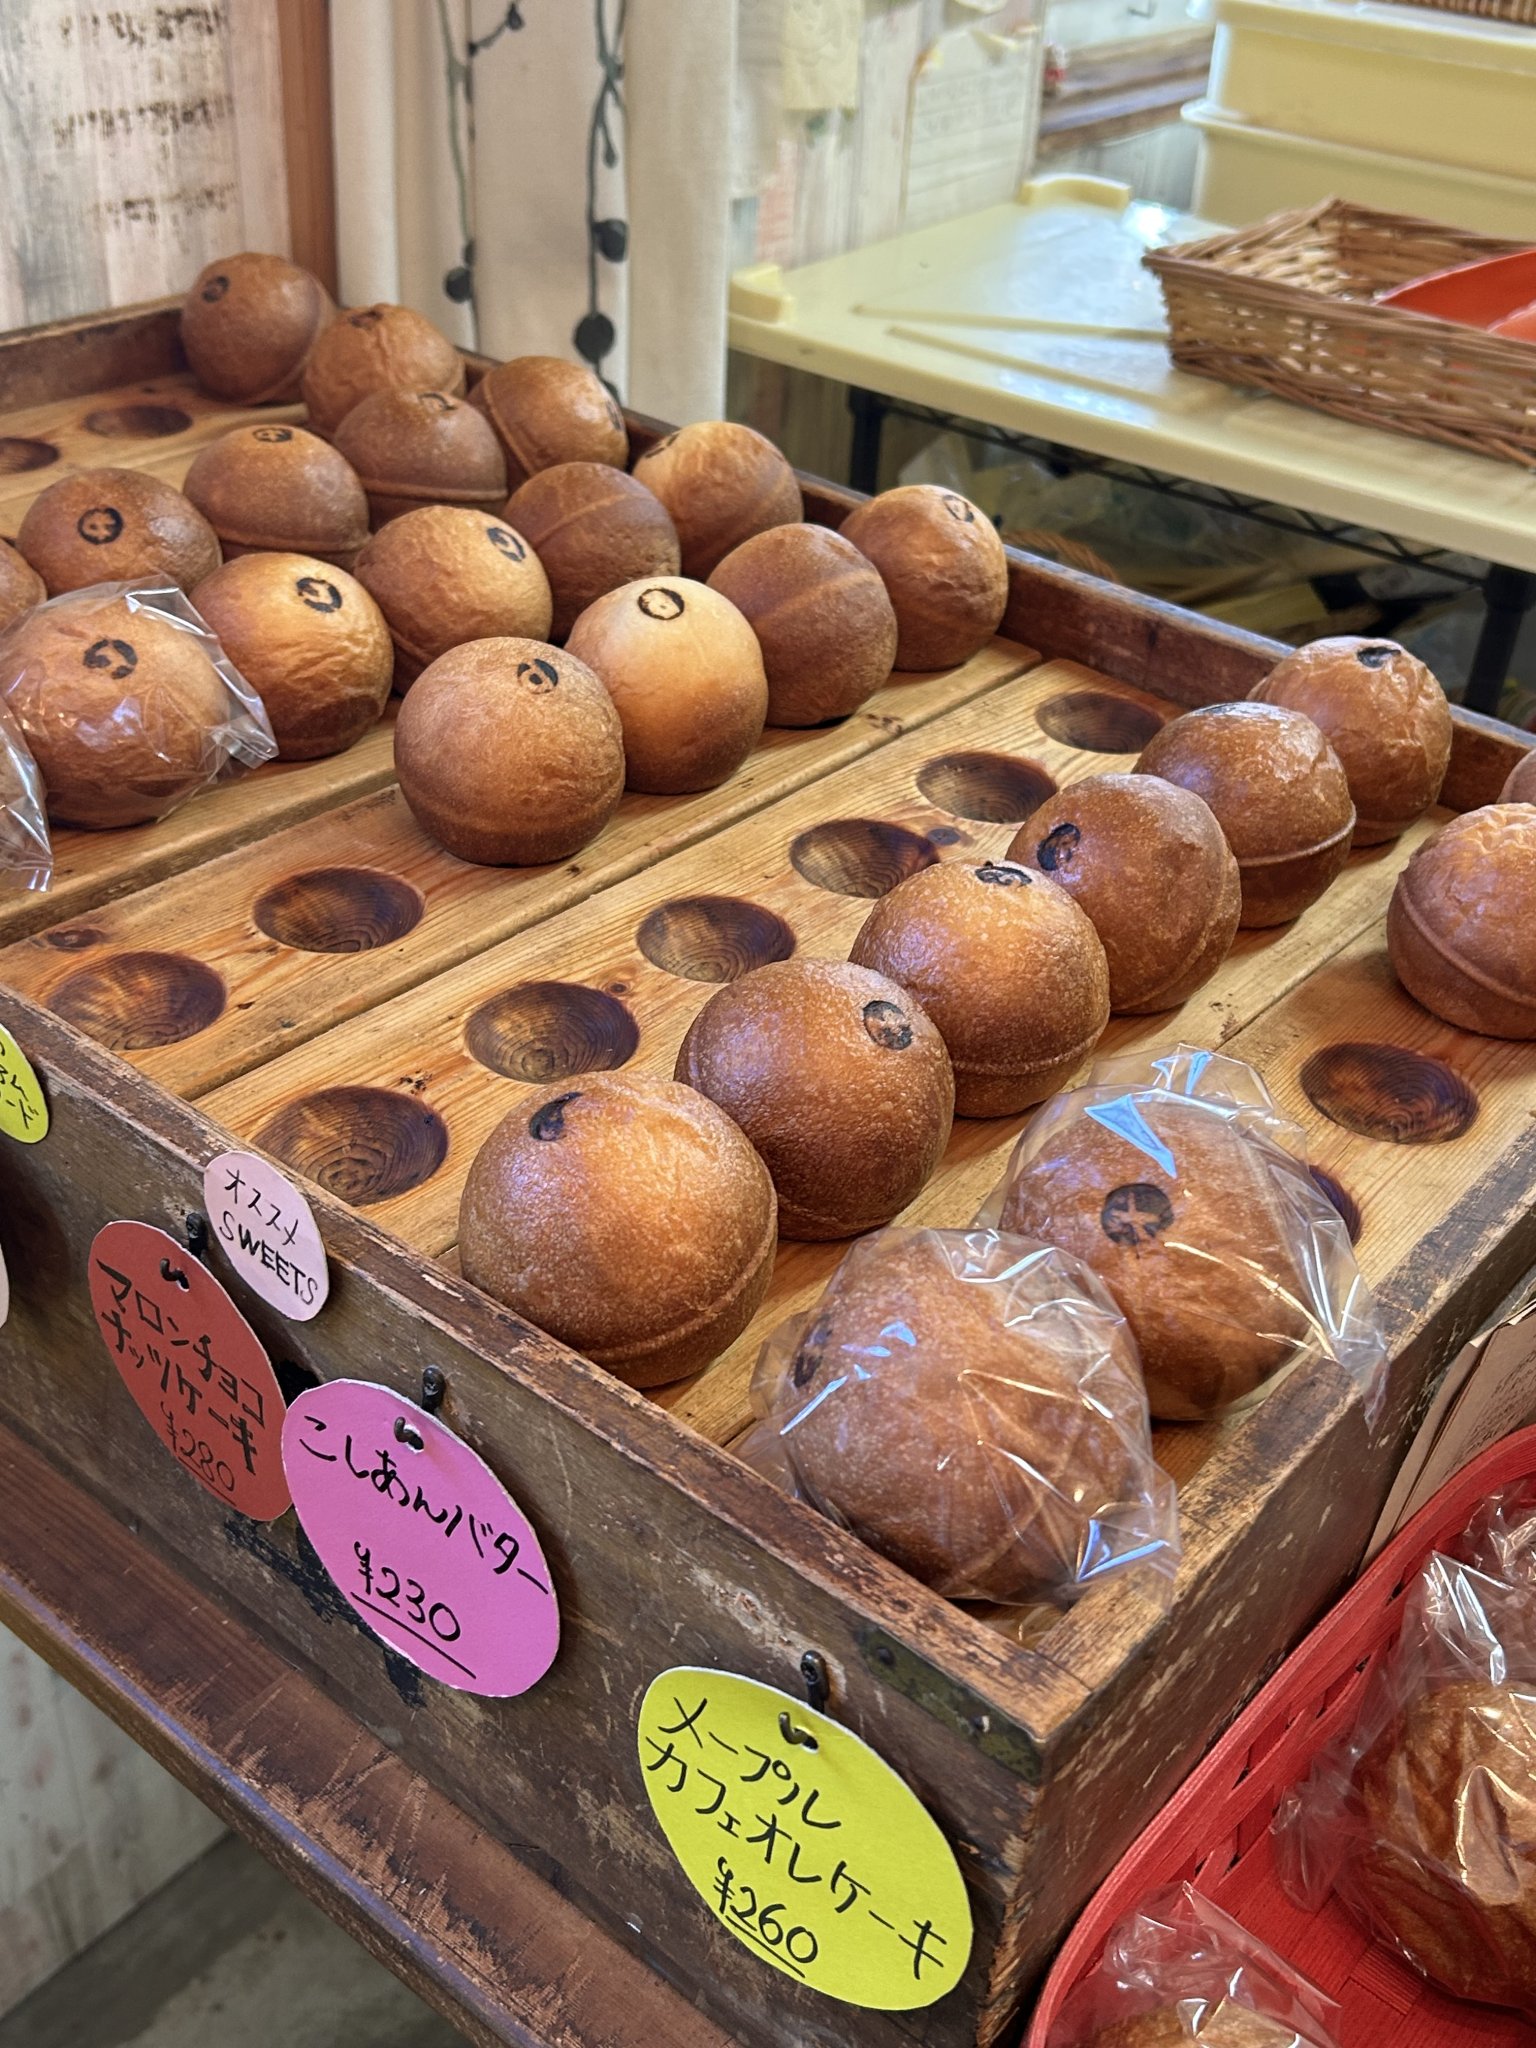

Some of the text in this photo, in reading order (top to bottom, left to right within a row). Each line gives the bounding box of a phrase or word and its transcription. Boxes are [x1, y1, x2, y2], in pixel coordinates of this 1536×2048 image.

[219, 1210, 319, 1306] SWEETS
[224, 1168, 299, 1246] オススメ
[96, 1258, 265, 1429] マロンチョコ
[101, 1309, 258, 1476] ナッツケーキ
[160, 1401, 236, 1493] ¥280
[299, 1415, 549, 1595] こしあんバター
[353, 1541, 461, 1642] ¥230
[658, 1697, 841, 1829] メープル
[645, 1736, 948, 1981] カフェオレケーキ
[713, 1856, 819, 1964] ¥260
